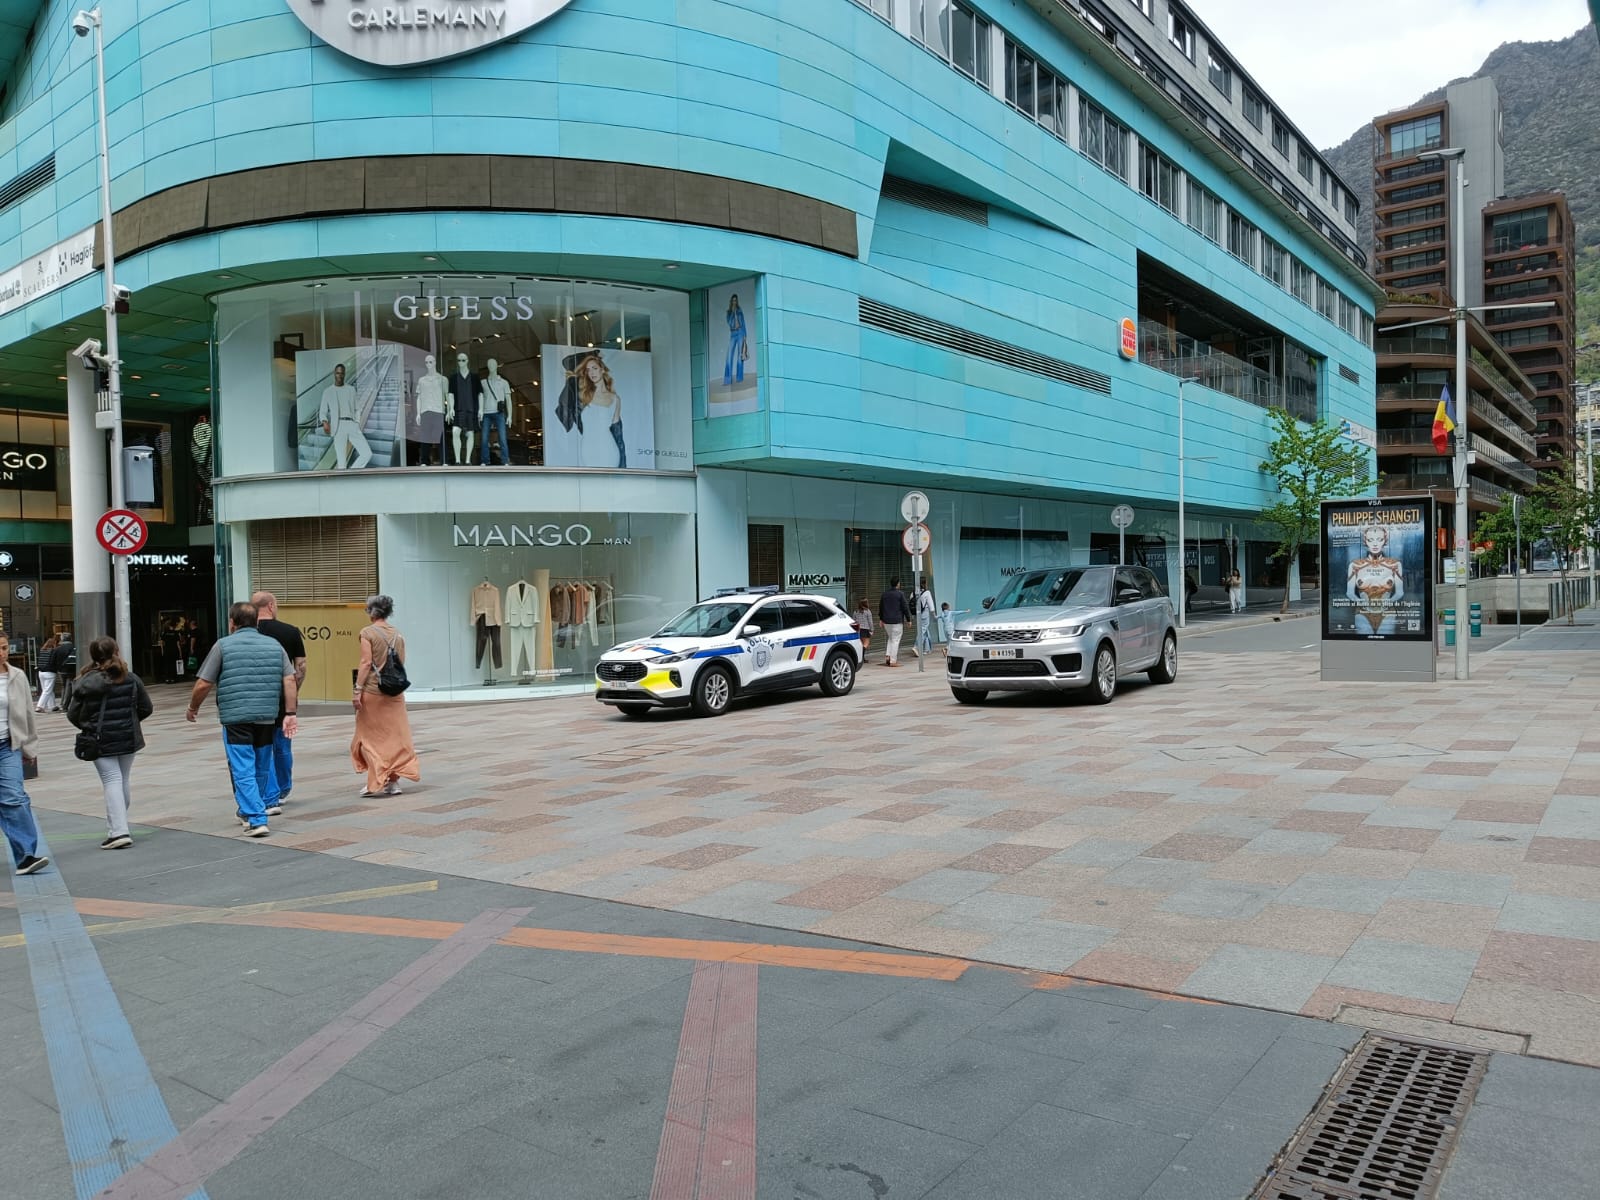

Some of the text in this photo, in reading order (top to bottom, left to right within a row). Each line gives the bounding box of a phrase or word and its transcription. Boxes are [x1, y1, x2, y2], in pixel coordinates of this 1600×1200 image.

[348, 6, 505, 28] CARLEMANY
[23, 271, 60, 298] SCALPERS
[393, 295, 534, 321] GUESS
[1332, 509, 1420, 526] PHILIPPE SHANGTI
[453, 524, 632, 546] MANGO MAN
[112, 554, 188, 565] ONTBLANC
[789, 574, 829, 586] MANGO
[746, 636, 775, 653] POLICIA
